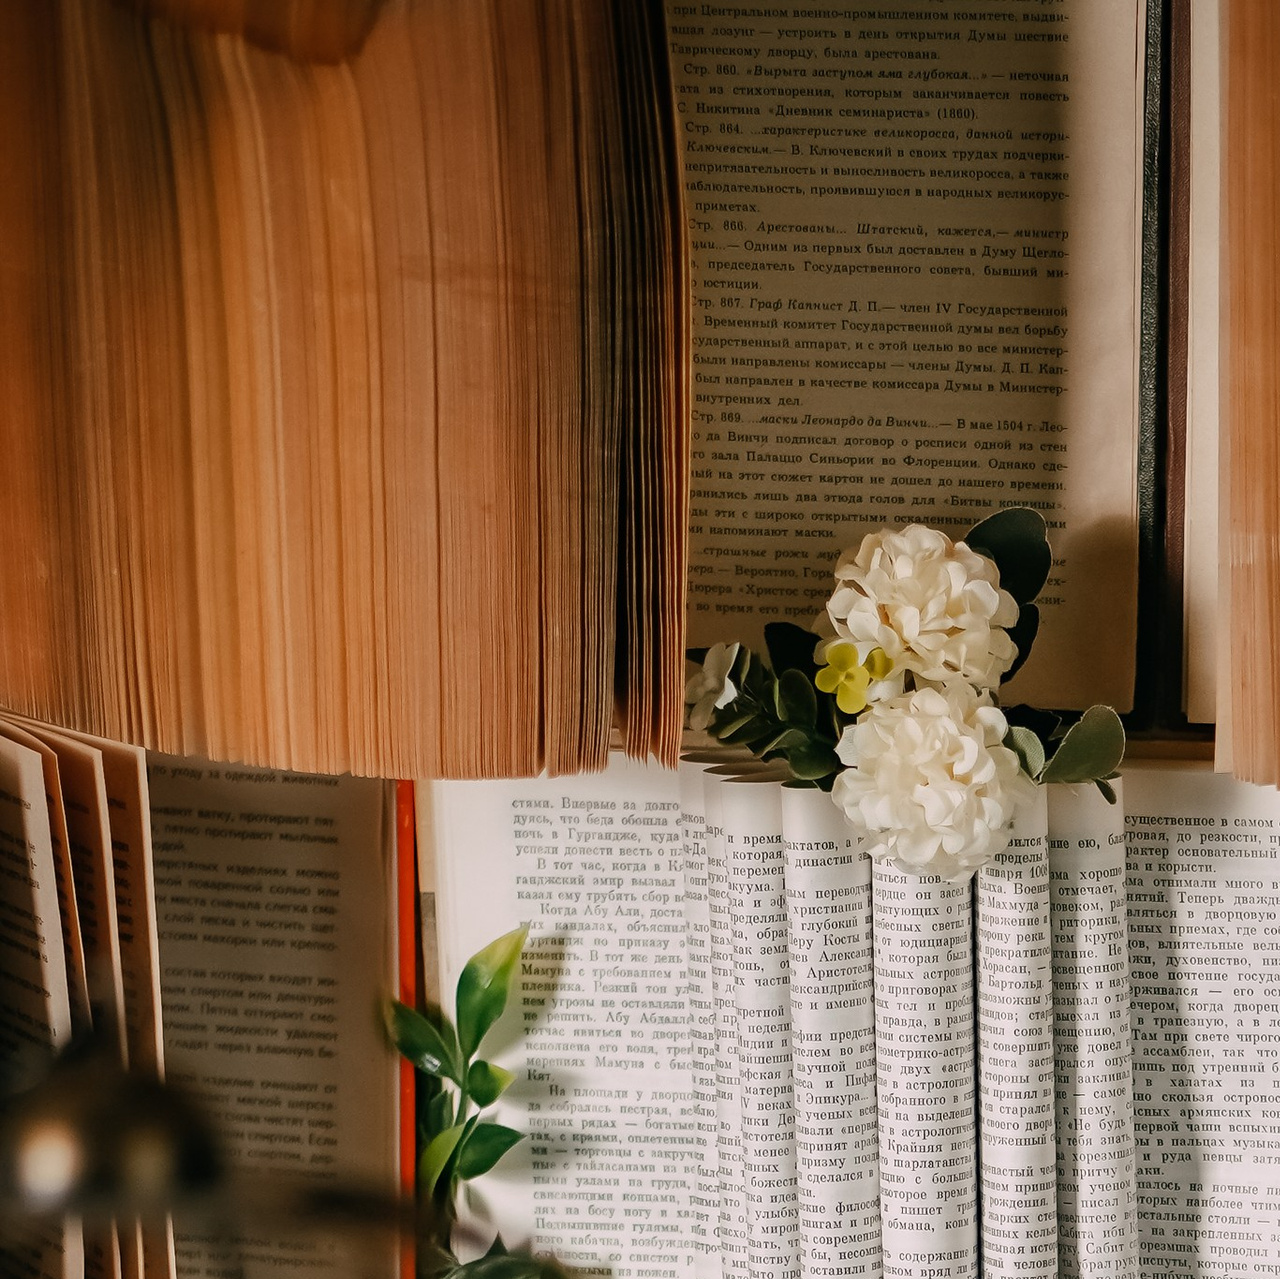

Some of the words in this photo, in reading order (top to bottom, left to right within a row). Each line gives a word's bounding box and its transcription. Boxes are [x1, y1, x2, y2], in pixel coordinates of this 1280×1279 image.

[673, 6, 697, 18] при
[701, 5, 788, 19] Центральном
[793, 10, 949, 21] военно-промышленном
[953, 12, 1018, 22] комитете,
[767, 48, 817, 60] дворцу,
[864, 50, 940, 61] арестована.
[684, 63, 710, 77] Стр.
[716, 64, 740, 75] 860.
[812, 69, 873, 81] заступом
[877, 70, 903, 79] яма
[1009, 72, 1069, 82] неточная
[696, 102, 760, 115] Никитина
[695, 202, 760, 213] приметах.
[744, 240, 787, 252] Одним
[867, 243, 893, 254] был
[981, 245, 1016, 259] Думу
[703, 280, 762, 290] юстиции.
[750, 297, 783, 312] Граф
[788, 299, 843, 311] Капнист
[900, 304, 930, 313] член
[936, 303, 952, 313] IV
[957, 303, 1068, 318] Государственной
[696, 394, 771, 406] внутренних
[777, 397, 803, 407] дел.
[728, 431, 768, 447] Винчи
[776, 436, 837, 445] подписал
[844, 437, 895, 449] договор
[709, 526, 789, 537] напоминают
[795, 529, 836, 538] маски.
[561, 796, 616, 812] Впервые
[1234, 819, 1273, 828] самом
[1200, 833, 1261, 845] резкости,
[612, 863, 646, 872] когда
[1177, 891, 1224, 906] Теперь
[540, 903, 577, 916] Когда
[1169, 925, 1229, 937] приемах,
[1236, 927, 1257, 937] где
[1166, 956, 1251, 968] духовенство,
[883, 1016, 927, 1029] правда,
[1153, 1018, 1228, 1029] трапезную,
[899, 1033, 952, 1043] системы
[1202, 1062, 1265, 1075] утренний
[899, 1249, 968, 1264] содержание
